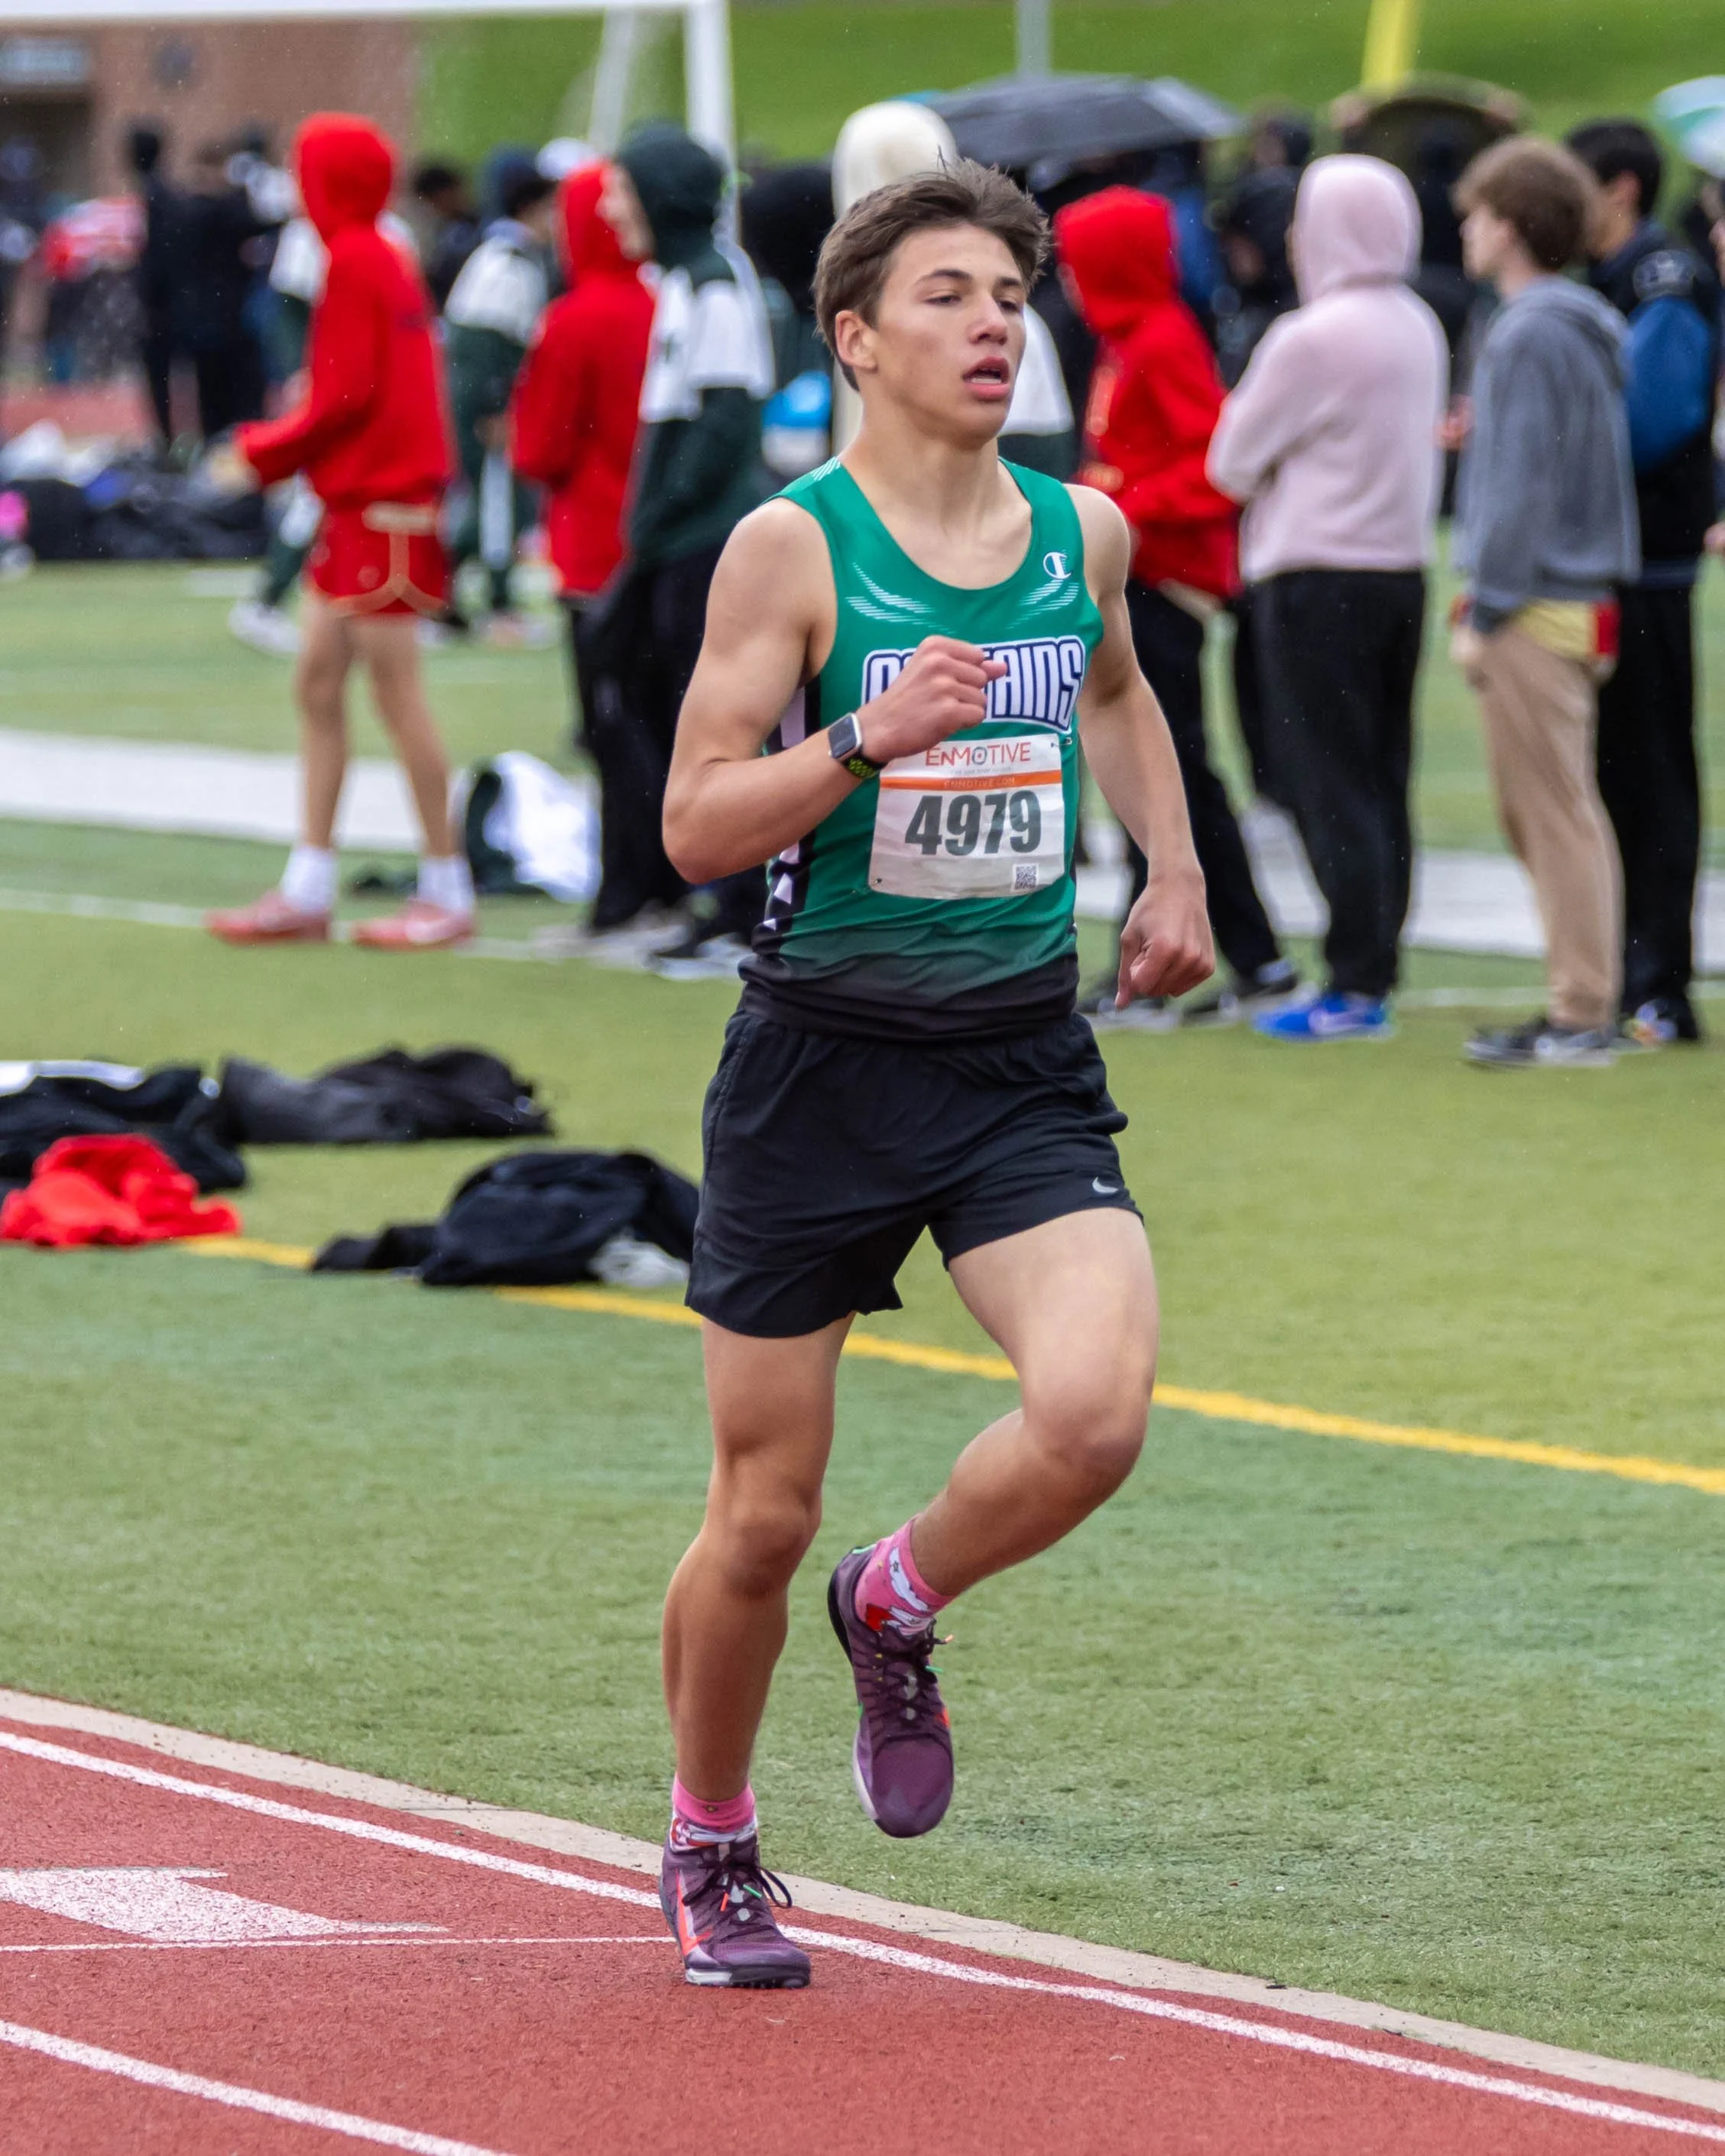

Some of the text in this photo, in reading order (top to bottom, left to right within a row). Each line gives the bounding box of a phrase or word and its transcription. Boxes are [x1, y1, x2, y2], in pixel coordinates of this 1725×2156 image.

[864, 637, 1085, 733] CAINS
[925, 741, 1032, 767] ENMOTIVE
[904, 789, 1042, 857] 4979
